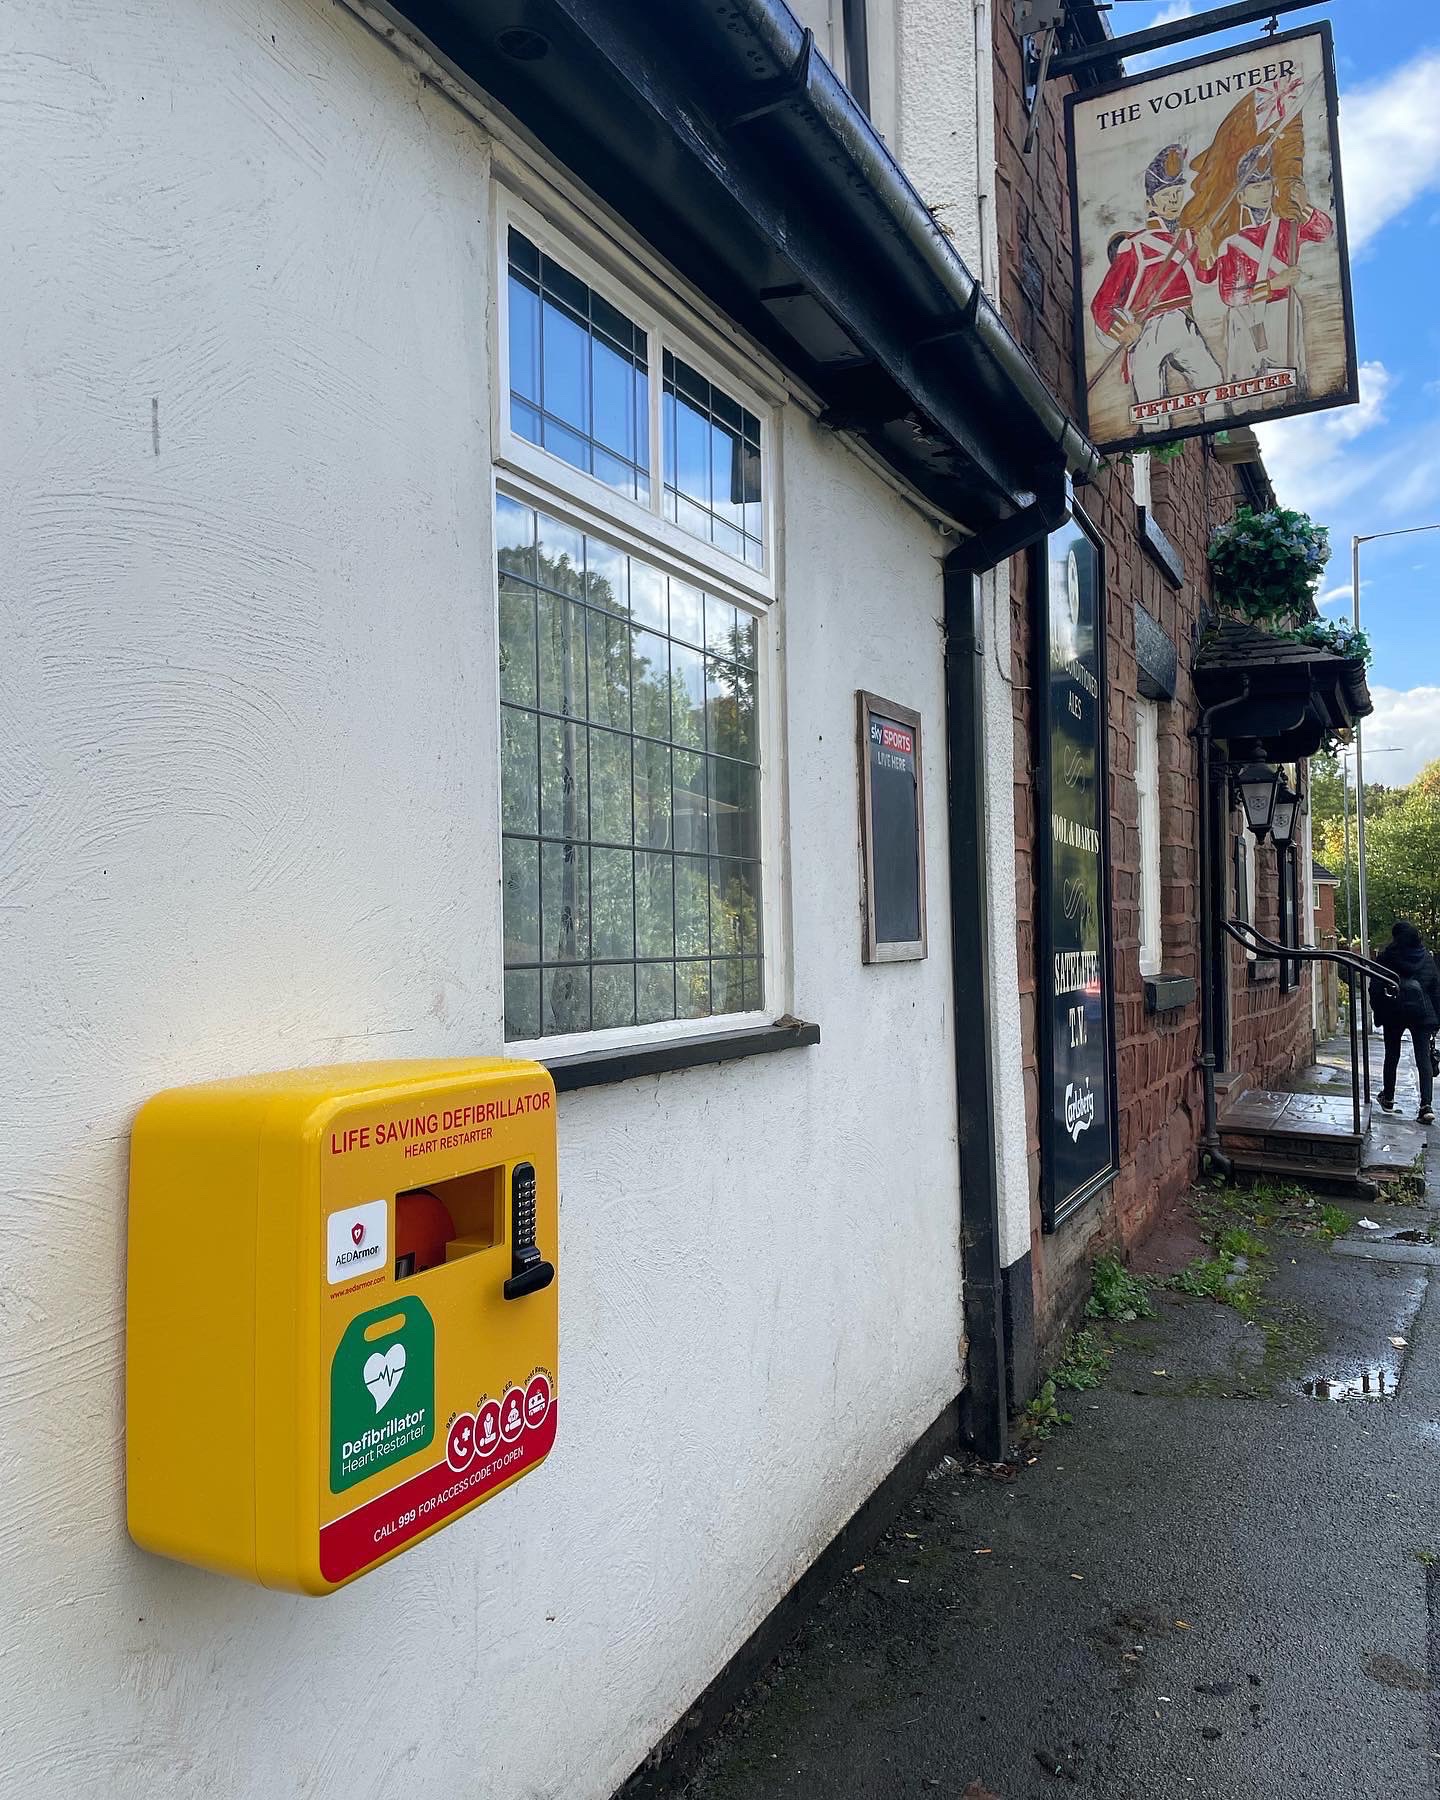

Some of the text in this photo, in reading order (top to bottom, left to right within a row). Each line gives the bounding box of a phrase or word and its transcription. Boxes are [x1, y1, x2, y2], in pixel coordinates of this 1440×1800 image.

[1096, 59, 1296, 131] THE VOLUNTEER
[1132, 372, 1294, 419] TETLEY BITTER
[1068, 690, 1082, 720] ALES
[871, 723, 911, 752] sky SPORTS
[877, 751, 906, 772] LIVE HERE
[1075, 823, 1100, 854] DARTS
[331, 1091, 551, 1155] LIFE SAVING DEFIBRILLATOR
[1065, 1076, 1094, 1141] Carlsberg
[404, 1127, 493, 1159] HEART RESTARTER
[335, 1245, 379, 1267] AEDArmor
[329, 1275, 386, 1300] www.aedarmor.com
[476, 1393, 488, 1408] CPR
[502, 1380, 513, 1395] AED
[342, 1408, 425, 1460] Defibrillator
[342, 1424, 426, 1477] Heart Restarter
[373, 1445, 524, 1542] CALL 999 FOR ACCESS CODE TO OPEN
